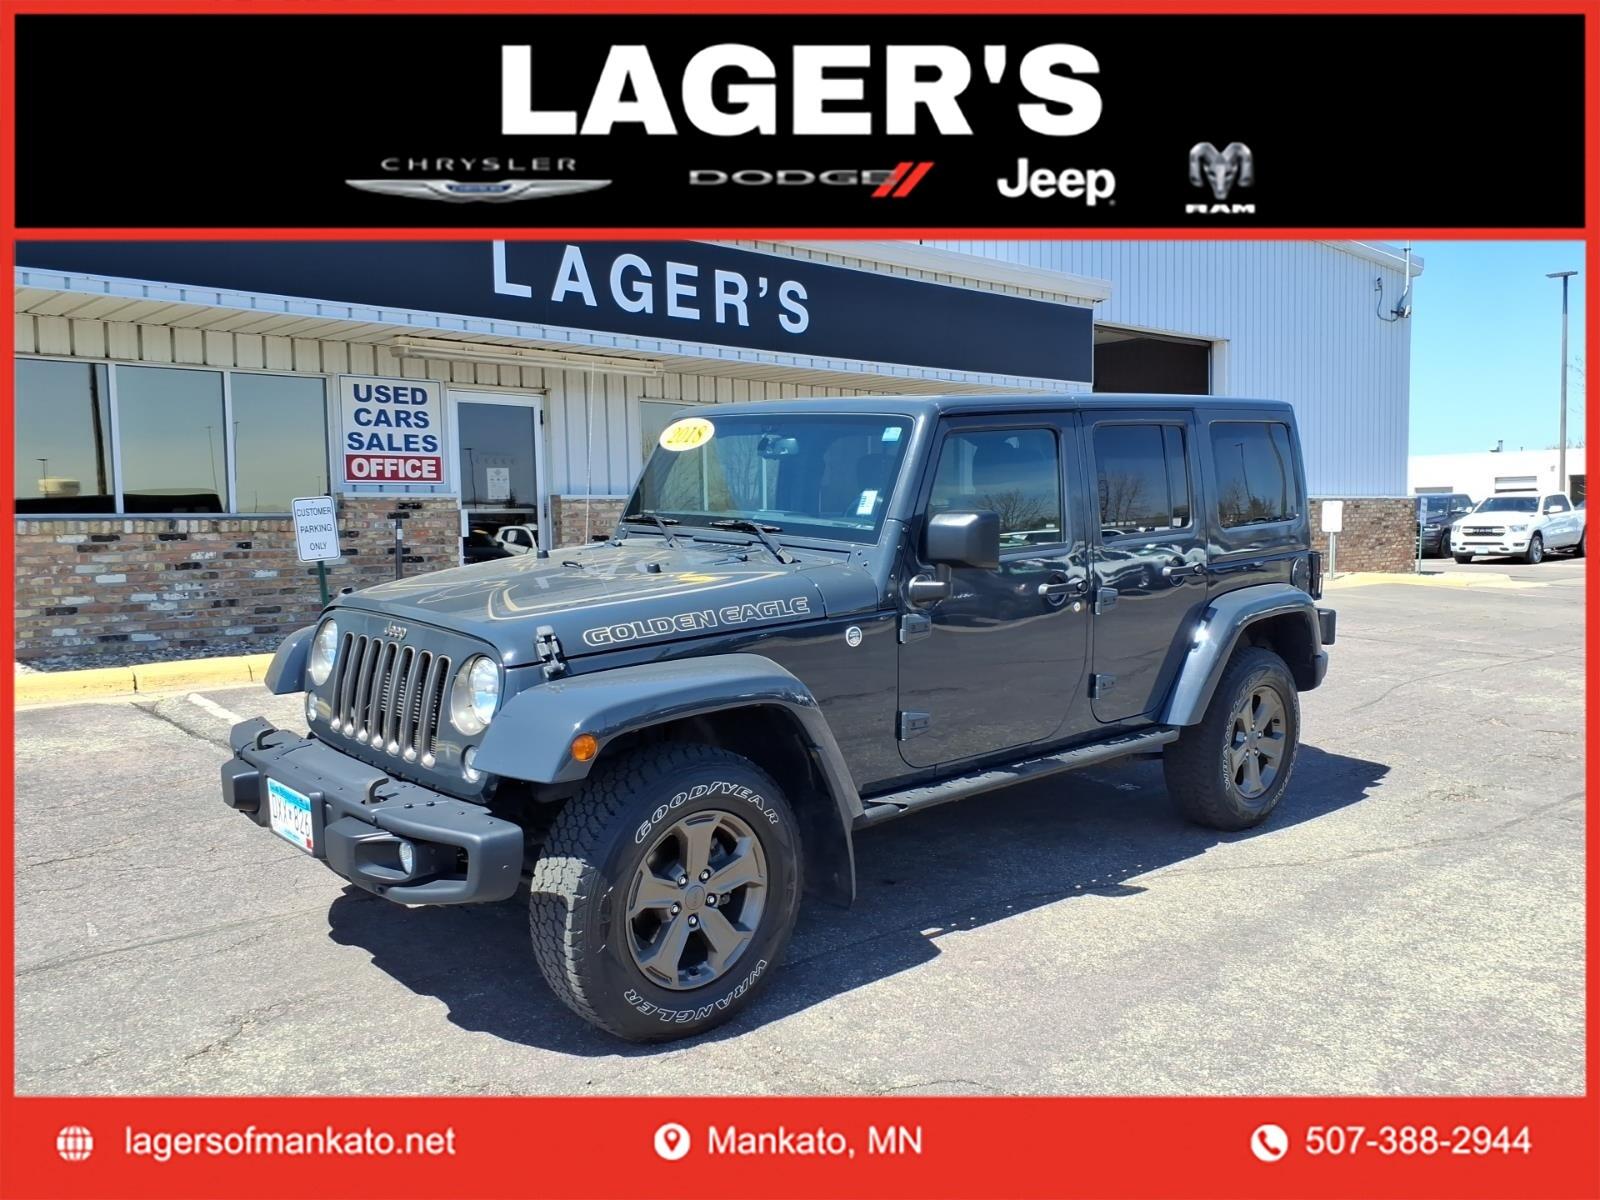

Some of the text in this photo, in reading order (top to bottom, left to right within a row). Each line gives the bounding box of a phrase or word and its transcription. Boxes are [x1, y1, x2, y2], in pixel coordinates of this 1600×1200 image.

[493, 239, 809, 334] LAGER'S
[353, 383, 428, 405] USED
[353, 407, 430, 429] CARS
[347, 431, 438, 452] SALES
[665, 425, 708, 445] 2018
[351, 457, 437, 478] OFFICE
[296, 506, 332, 517] CUSTOMER
[300, 523, 333, 534] PARKING
[309, 542, 328, 551] ONLY
[384, 620, 407, 641] Jeep
[582, 596, 811, 647] GOLDEN EAGLE
[635, 781, 780, 844] GOODYEAR
[623, 958, 768, 1023] WRANGLER
